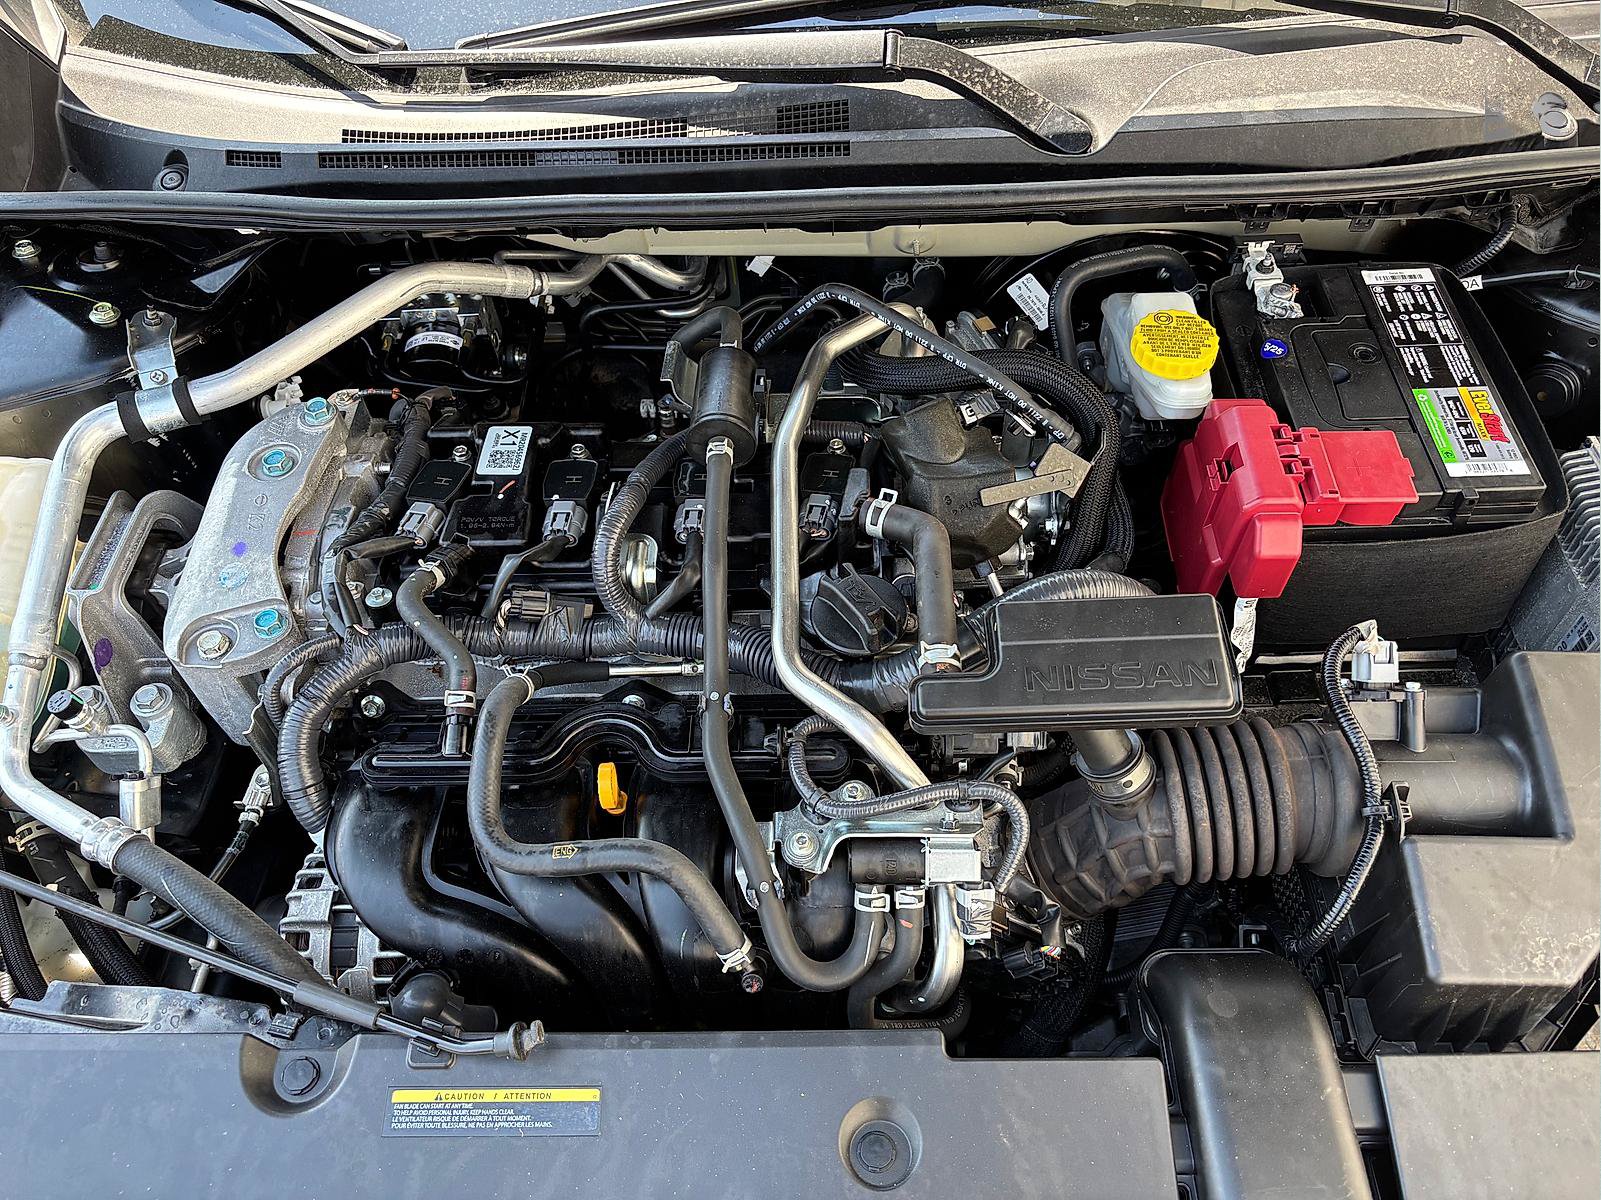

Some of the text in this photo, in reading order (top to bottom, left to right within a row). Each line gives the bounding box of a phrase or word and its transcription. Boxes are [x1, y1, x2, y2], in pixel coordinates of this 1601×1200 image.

[986, 376, 1004, 392] KINK
[1004, 390, 1019, 402] NOT
[500, 429, 521, 446] X1
[1024, 659, 1219, 692] NISSAN
[444, 1092, 485, 1100] CAUTION
[504, 1092, 552, 1100] ATTENTION
